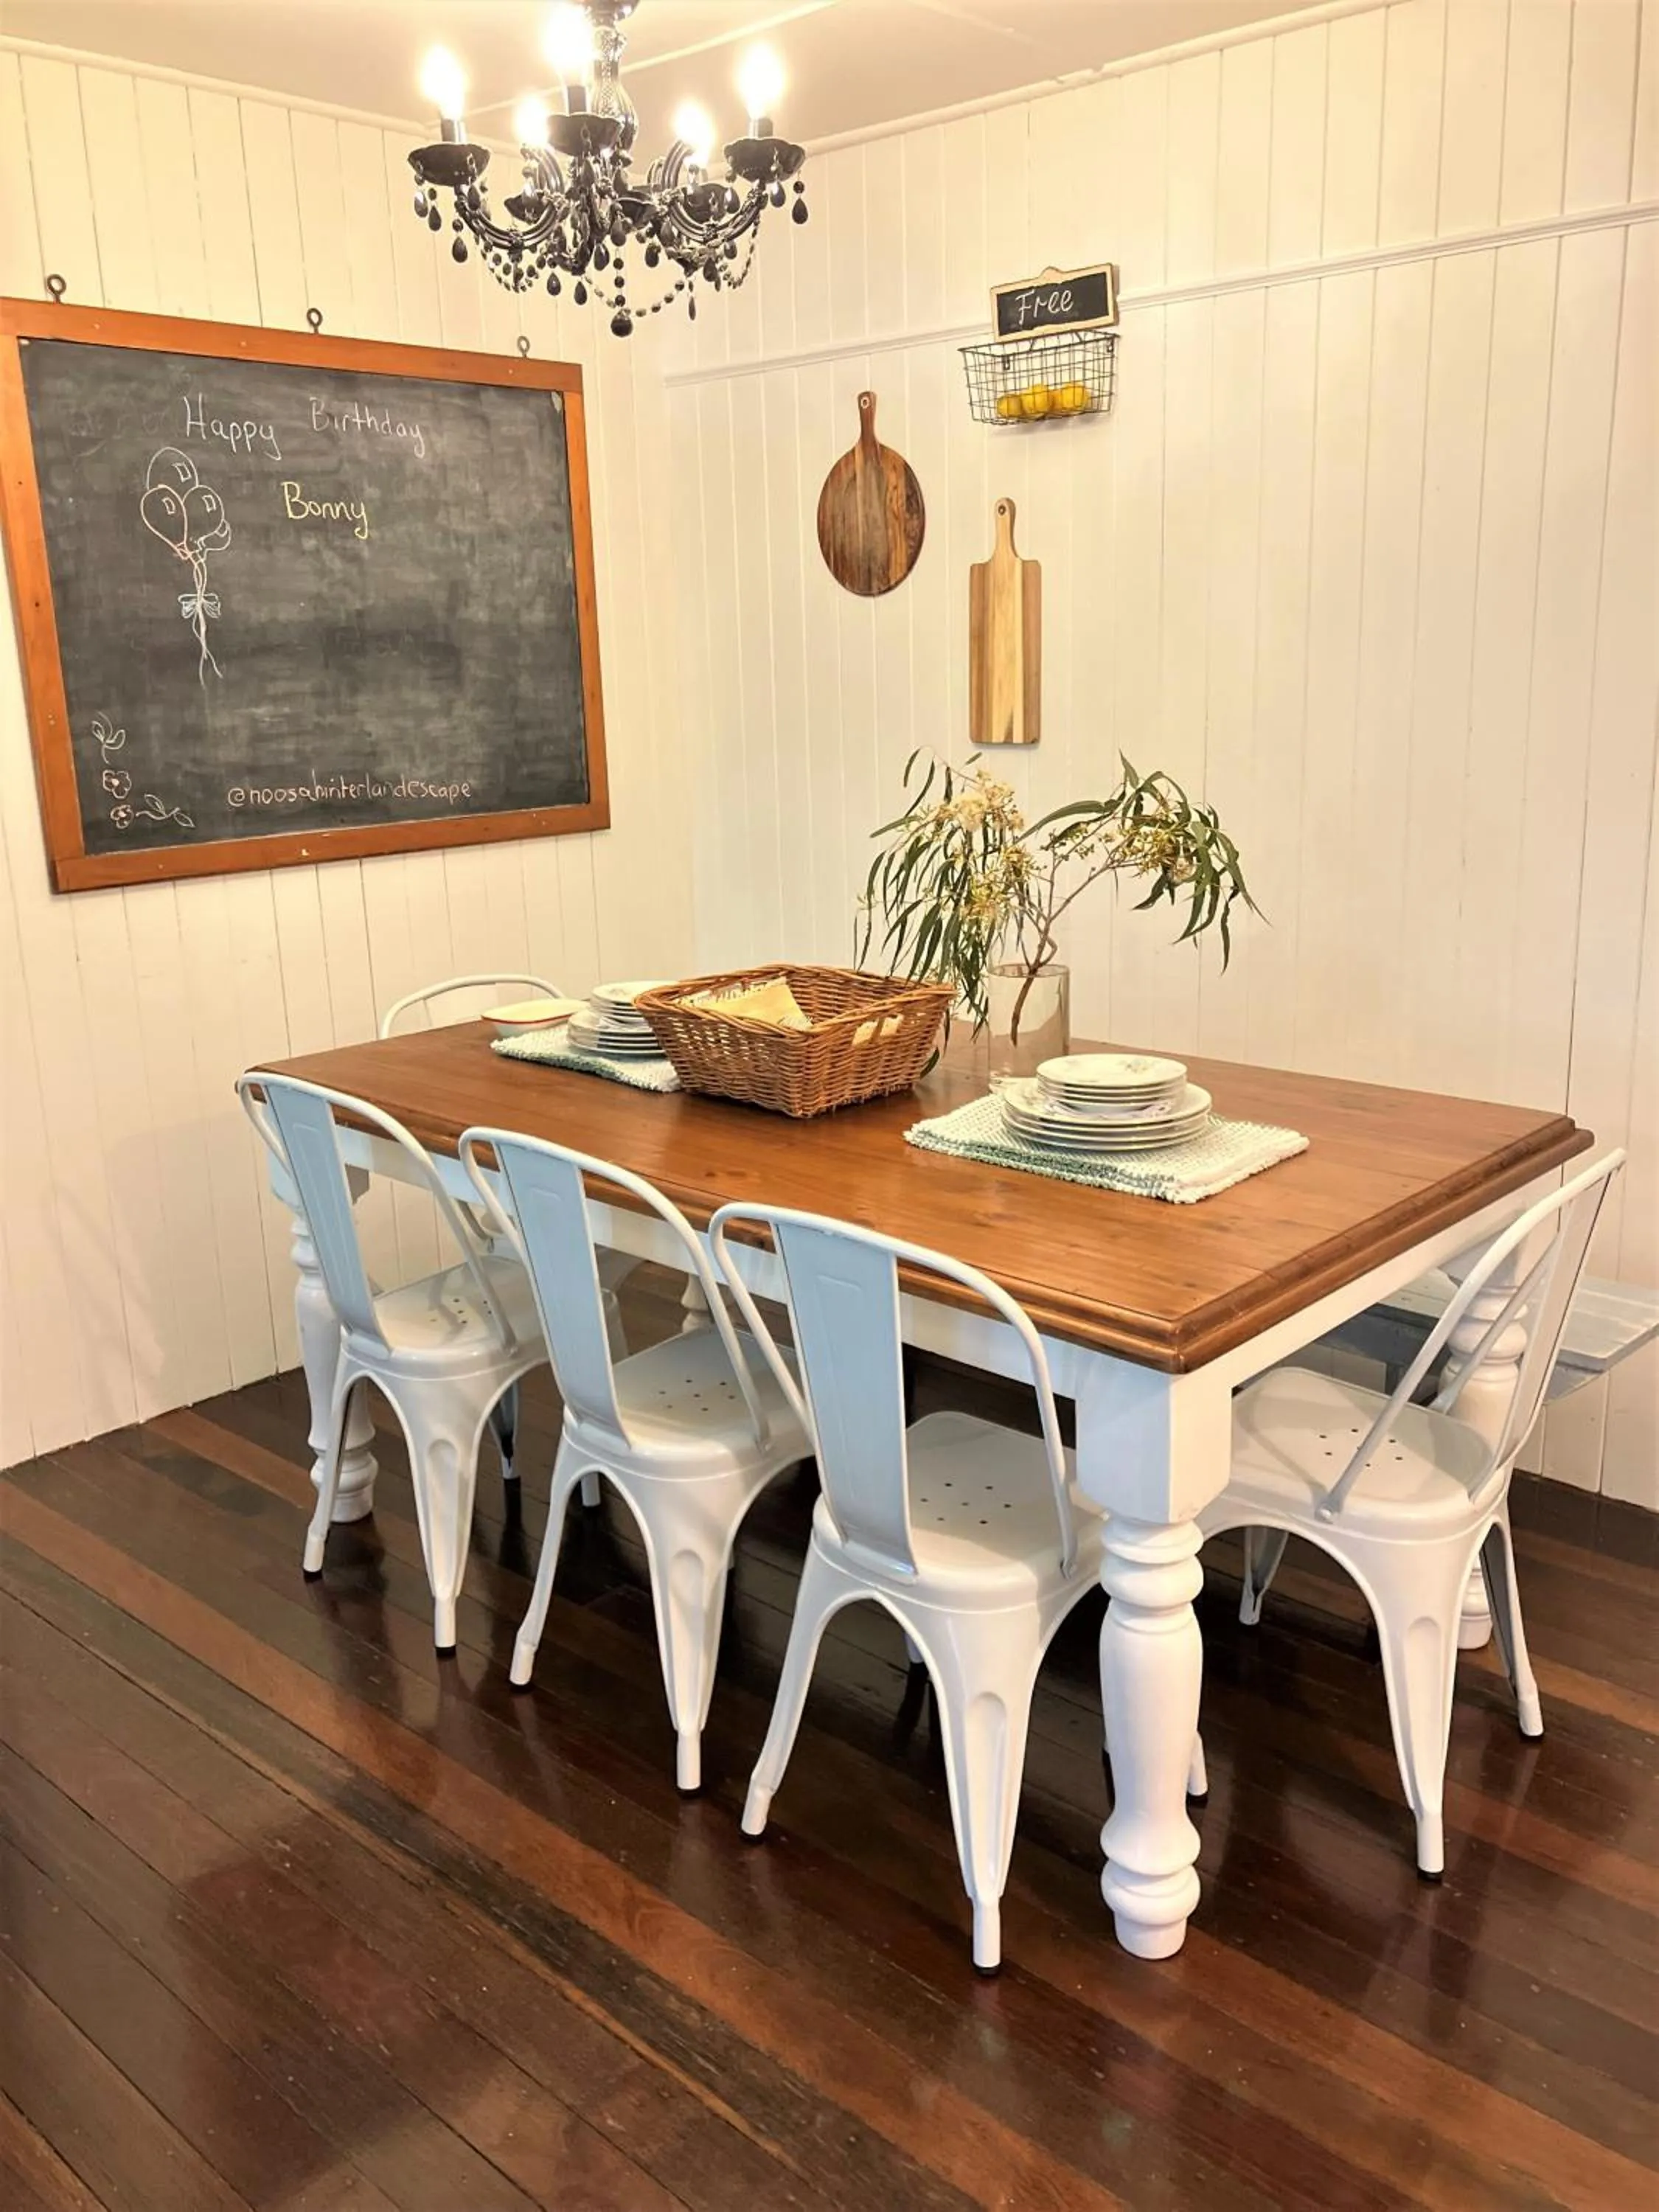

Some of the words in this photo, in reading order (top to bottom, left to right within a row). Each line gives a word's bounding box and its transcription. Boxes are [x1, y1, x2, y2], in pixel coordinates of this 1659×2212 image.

[1015, 289, 1074, 324] Free
[183, 392, 282, 461] Happy
[309, 396, 425, 459] Birthday
[281, 481, 368, 540] Bonny
